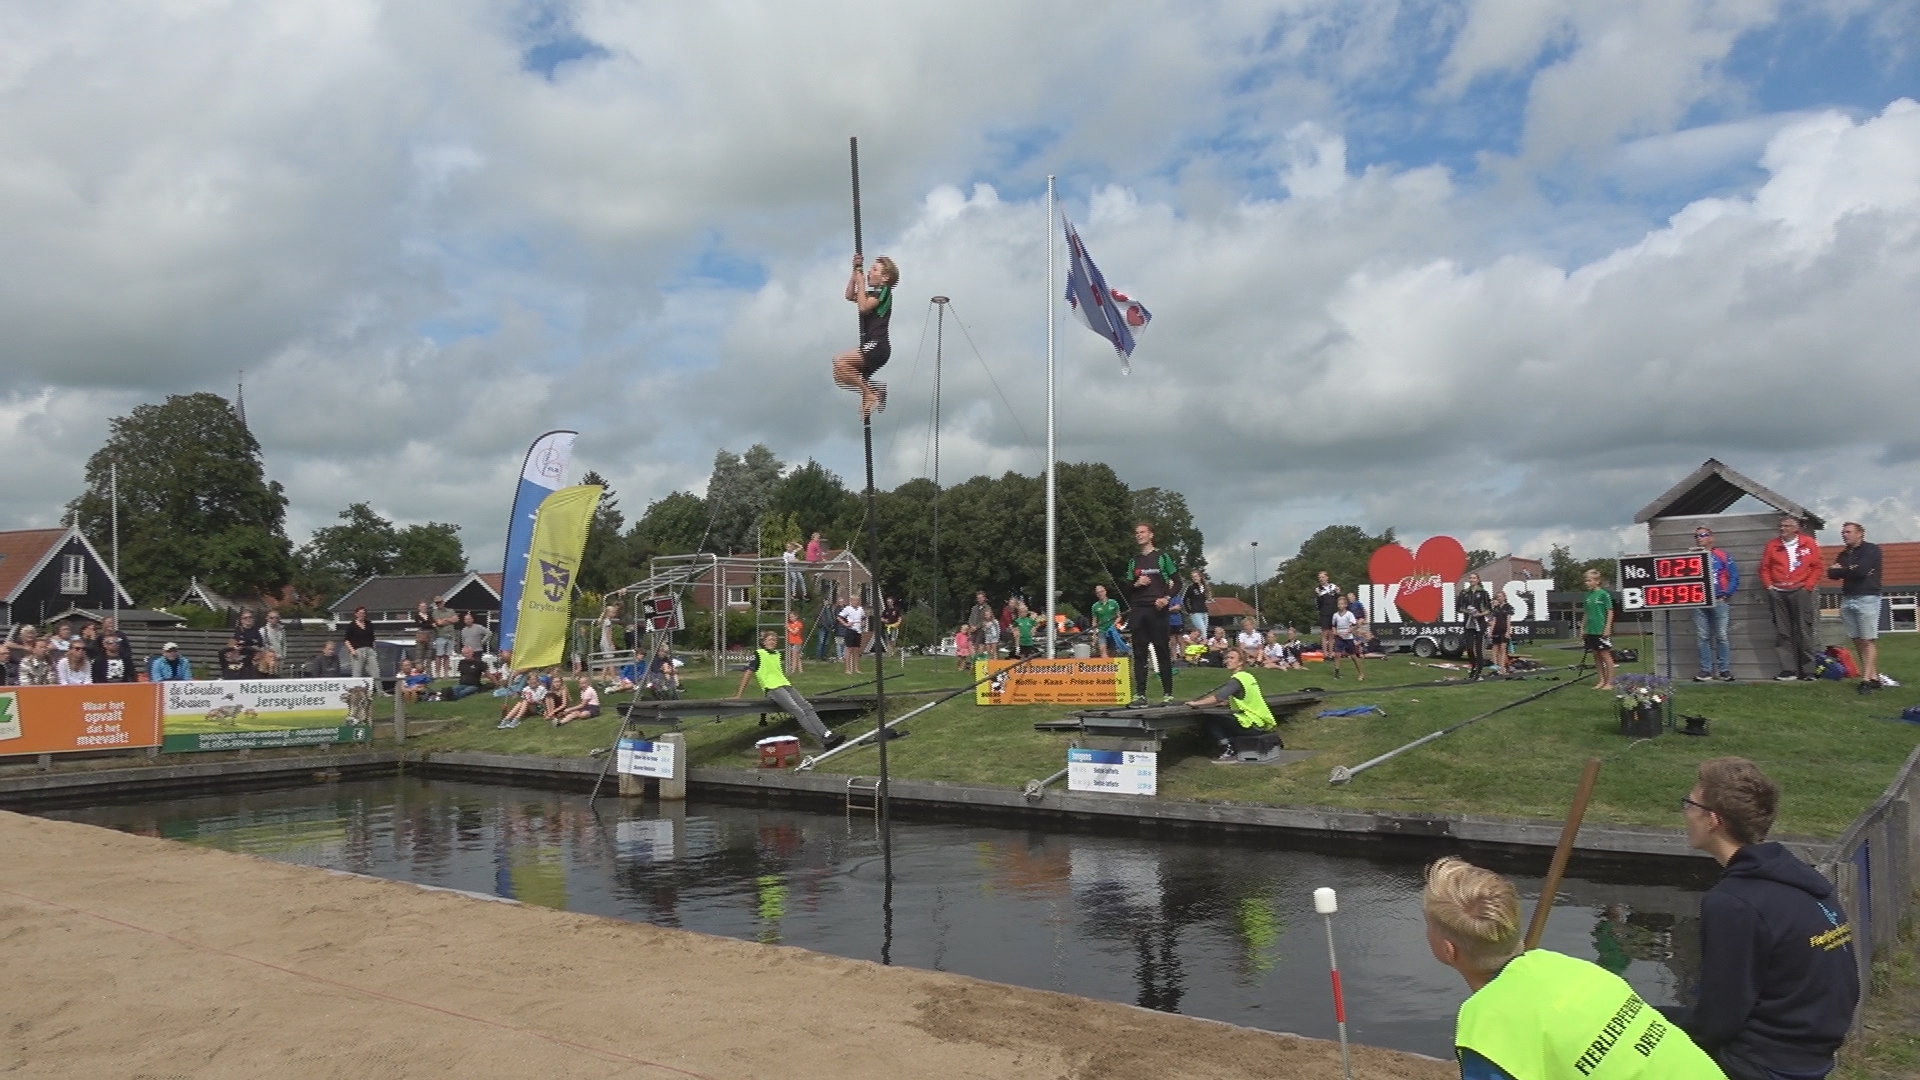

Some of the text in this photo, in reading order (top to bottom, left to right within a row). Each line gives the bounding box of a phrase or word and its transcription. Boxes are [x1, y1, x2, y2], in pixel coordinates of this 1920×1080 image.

[1625, 558, 1701, 579] No. 029
[1623, 585, 1703, 609] B 0996
[646, 618, 655, 632] A
[1400, 626, 1417, 635] 750
[1420, 626, 1445, 635] JAAR
[1536, 627, 1556, 635] 2018
[1029, 662, 1074, 675] boerderij
[240, 681, 340, 694] Natuurexcursies
[1070, 677, 1095, 685] Friese
[1096, 676, 1123, 685] kado's
[169, 682, 223, 696] de Gouden
[83, 701, 125, 711] Waar het
[255, 695, 326, 709] Jerseyvlees
[85, 710, 122, 724] opvalt
[87, 723, 121, 734] dat het
[77, 732, 129, 746] meevalt!
